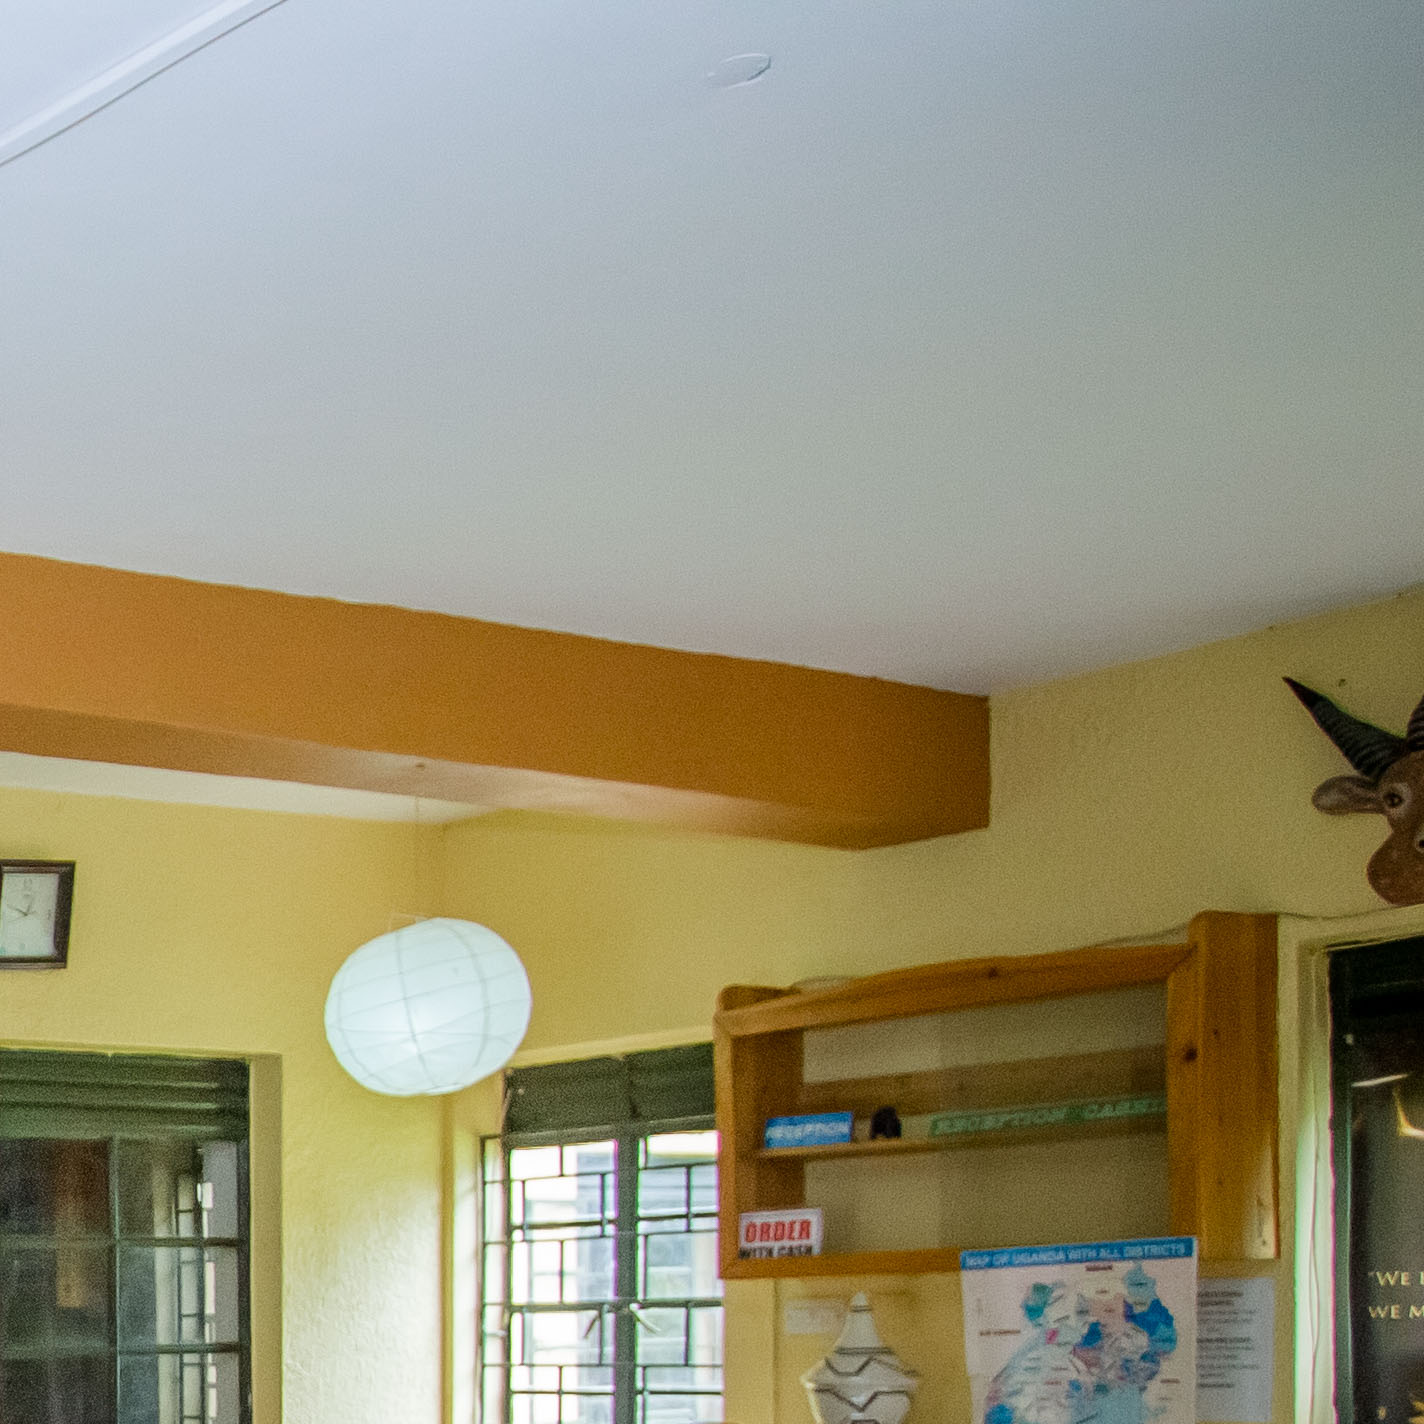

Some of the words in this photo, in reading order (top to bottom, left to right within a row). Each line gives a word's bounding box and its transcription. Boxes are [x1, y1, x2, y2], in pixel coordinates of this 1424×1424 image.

[745, 1219, 811, 1242] ORDER
[964, 1254, 989, 1267] MAP
[991, 1252, 1009, 1265] OF
[1011, 1250, 1066, 1265] UGANDA
[1067, 1248, 1097, 1261] WITH
[1099, 1247, 1122, 1259] ALL
[1123, 1244, 1186, 1258] DISTRICTS
[1368, 1304, 1400, 1319] WE
